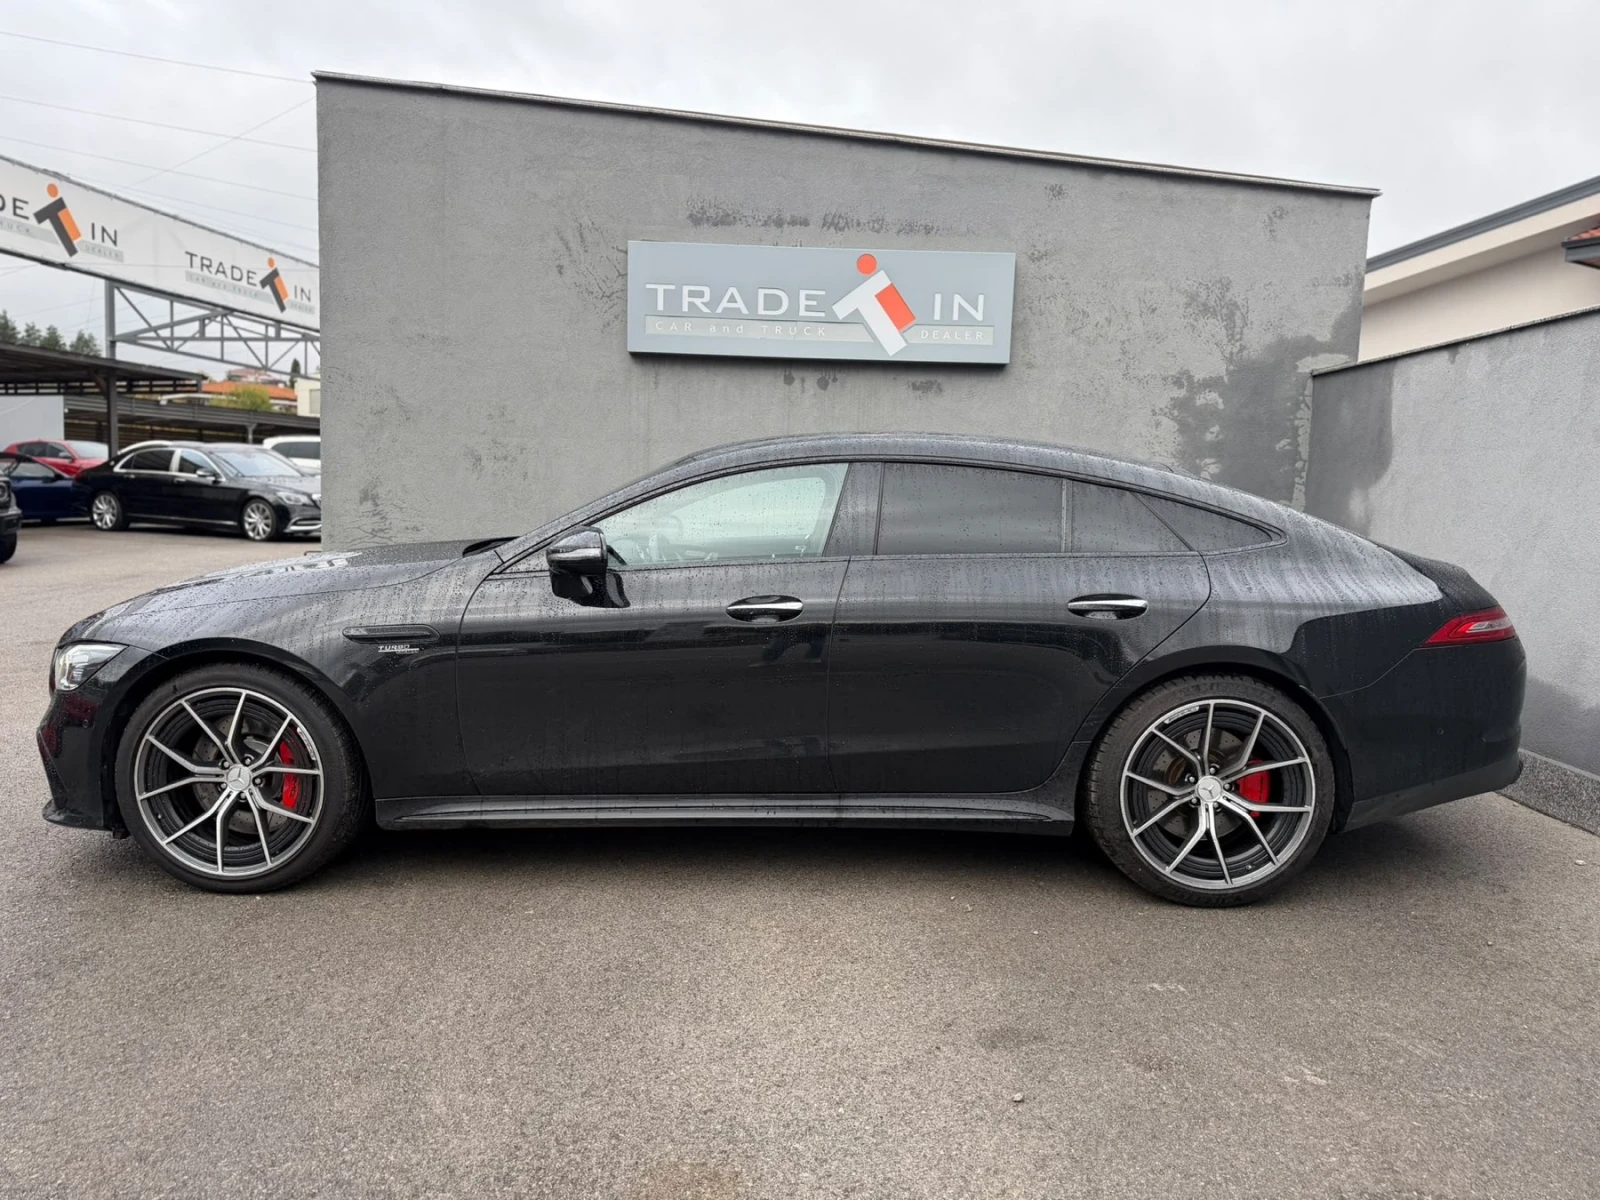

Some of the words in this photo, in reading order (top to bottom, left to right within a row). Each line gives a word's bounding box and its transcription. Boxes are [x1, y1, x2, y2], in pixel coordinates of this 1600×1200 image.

[91, 222, 118, 247] IN
[185, 250, 257, 287] TRADE
[294, 285, 311, 302] IN
[645, 284, 826, 317] TRADE
[933, 293, 985, 321] IN
[655, 321, 692, 332] CAR
[709, 325, 744, 334] and
[761, 325, 825, 336] TRUCK
[920, 330, 984, 340] DEALER
